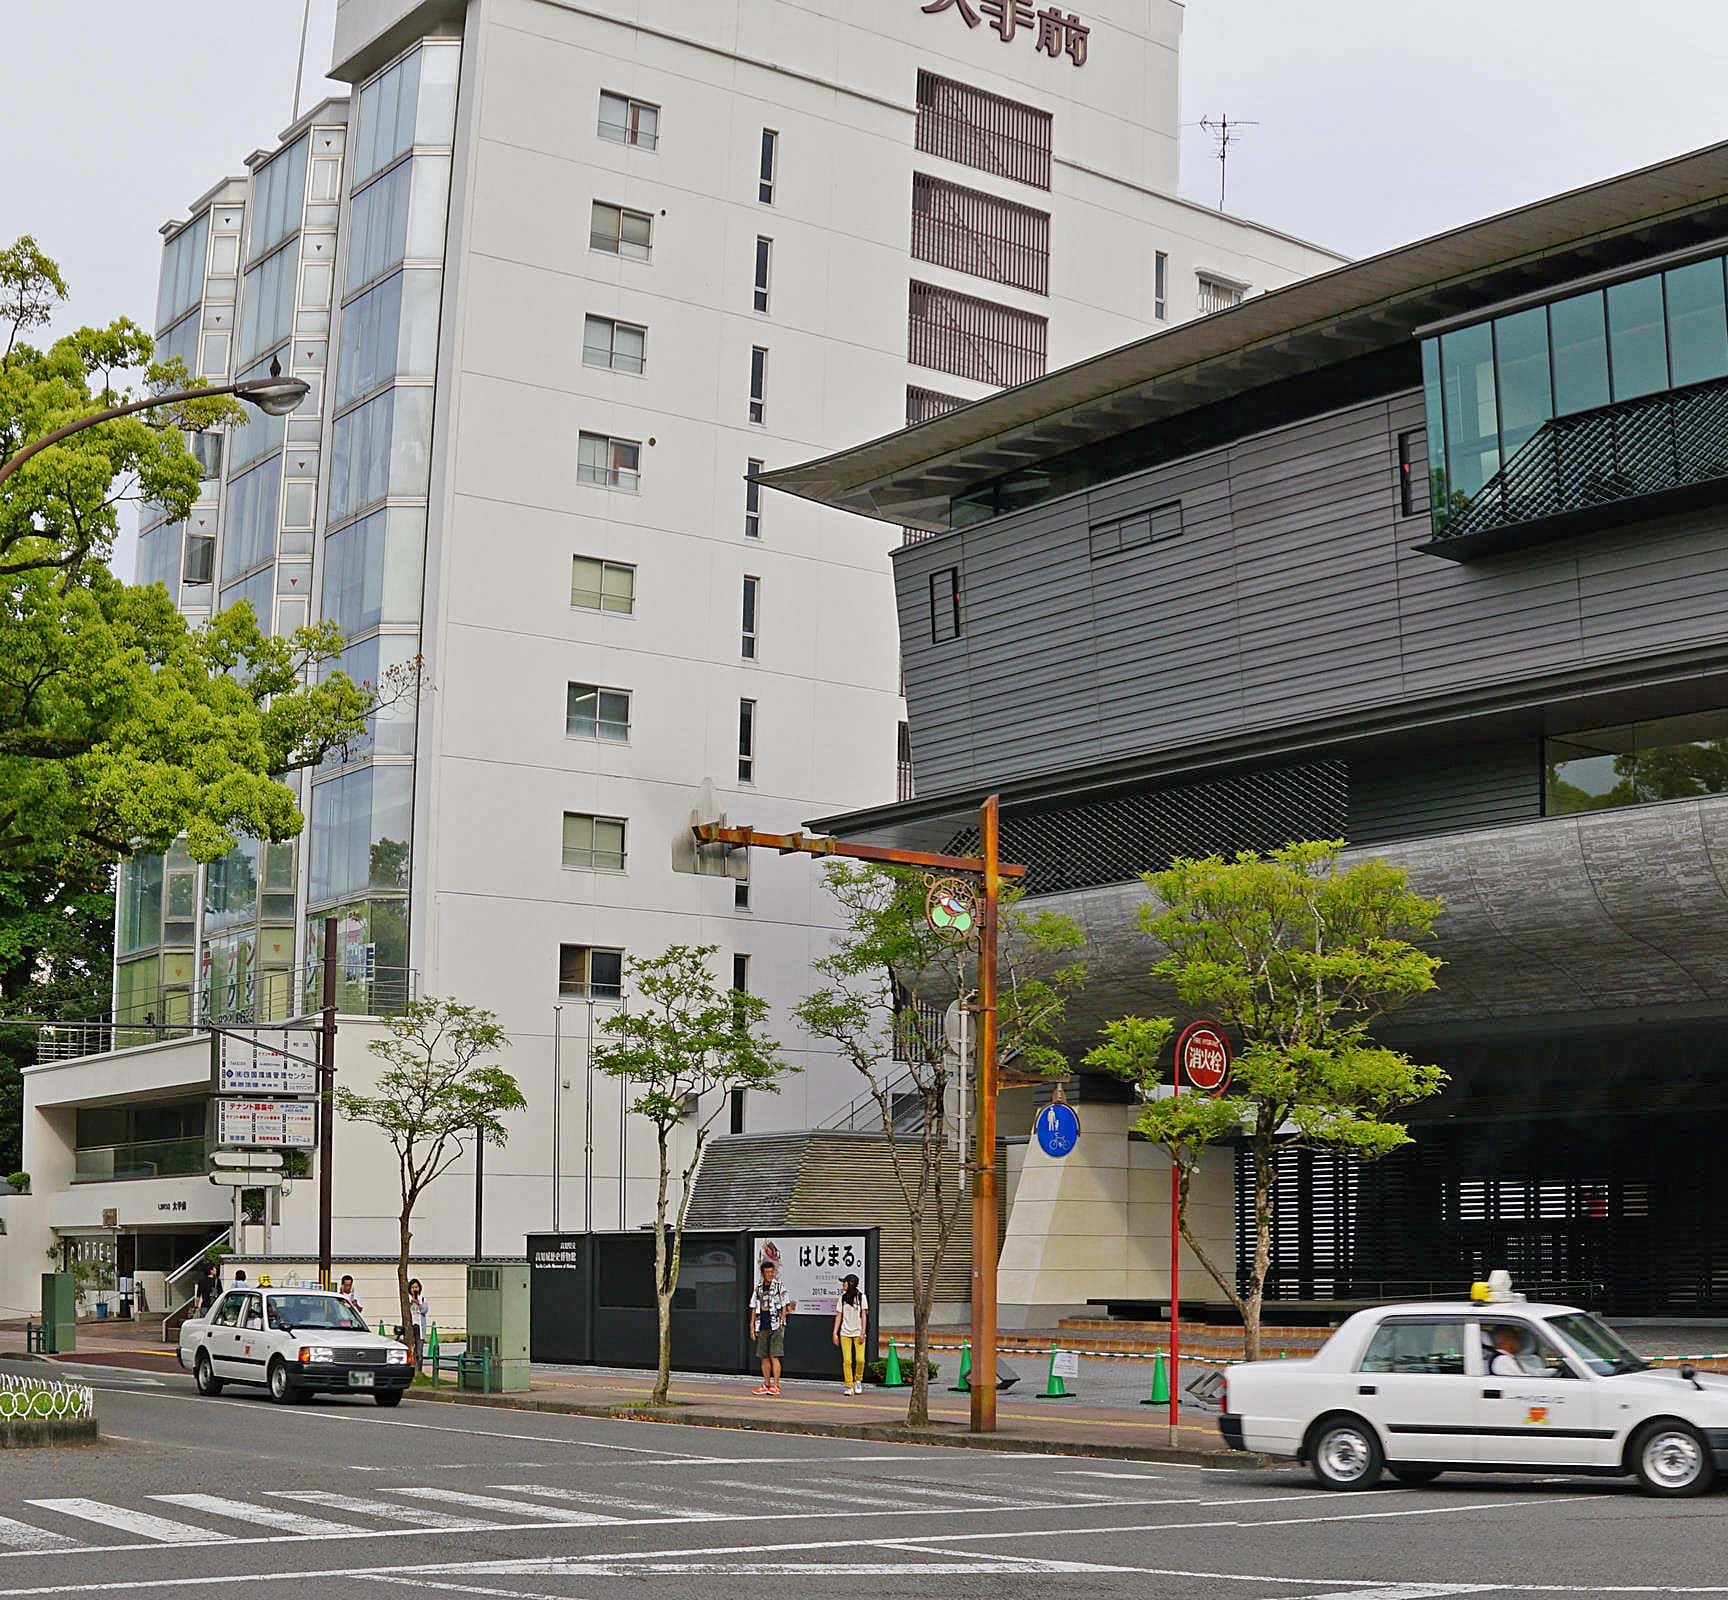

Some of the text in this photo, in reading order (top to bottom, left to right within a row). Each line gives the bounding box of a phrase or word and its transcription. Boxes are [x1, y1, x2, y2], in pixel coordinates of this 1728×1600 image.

[1189, 1047, 1222, 1073] 消火栓
[70, 1240, 112, 1264] COFFEE
[799, 1245, 861, 1268] はじまる。
